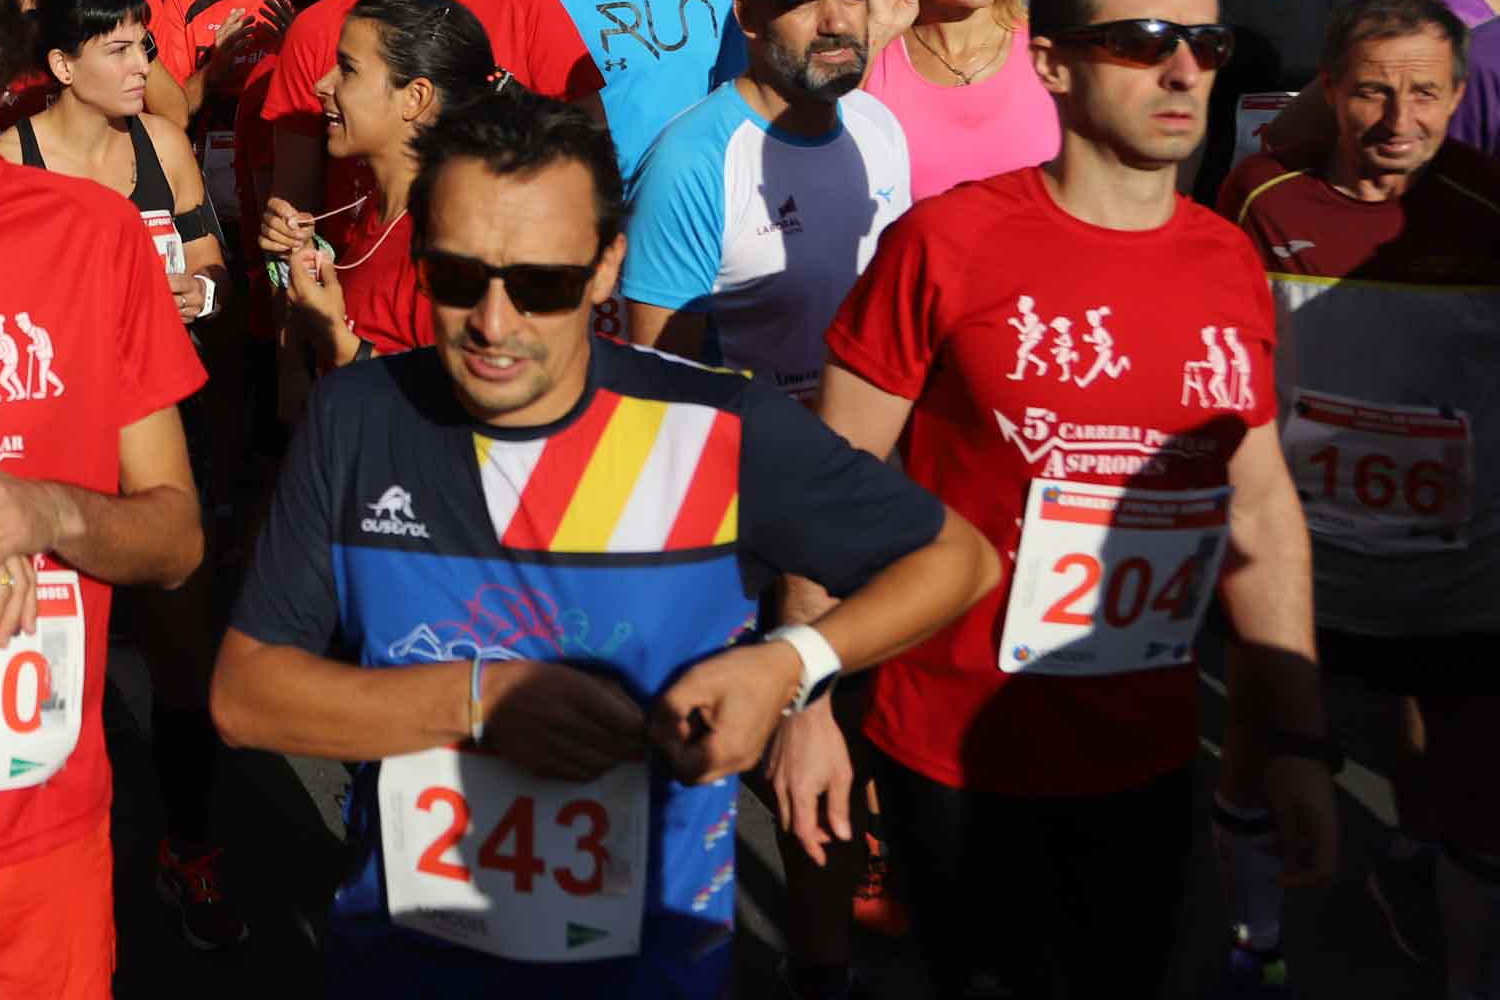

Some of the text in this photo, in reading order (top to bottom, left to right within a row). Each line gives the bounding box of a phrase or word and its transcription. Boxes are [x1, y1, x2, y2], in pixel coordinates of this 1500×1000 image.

[1058, 422, 1141, 441] CARRERA
[1309, 445, 1446, 515] 166
[1040, 552, 1196, 629] 204
[415, 785, 612, 897] 243
